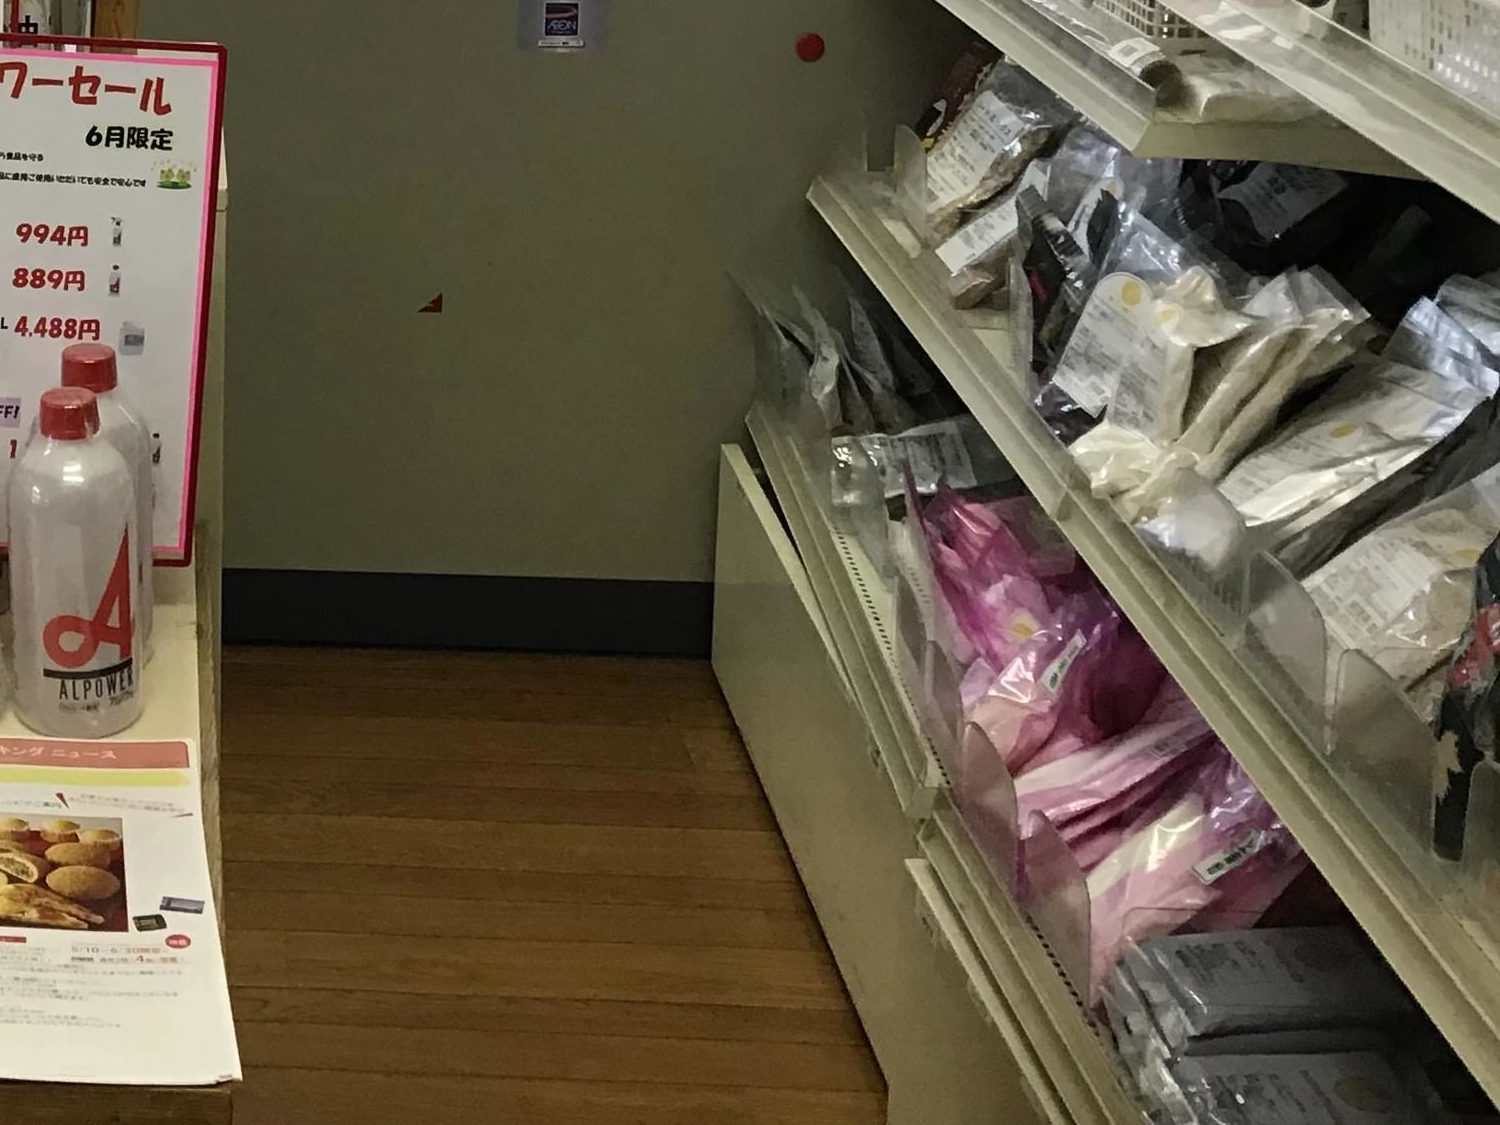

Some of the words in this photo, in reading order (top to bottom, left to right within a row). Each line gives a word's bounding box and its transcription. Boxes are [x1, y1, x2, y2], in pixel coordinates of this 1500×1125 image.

[85, 125, 174, 152] 6月限定
[15, 223, 90, 248] 994円
[12, 268, 86, 292] 889円
